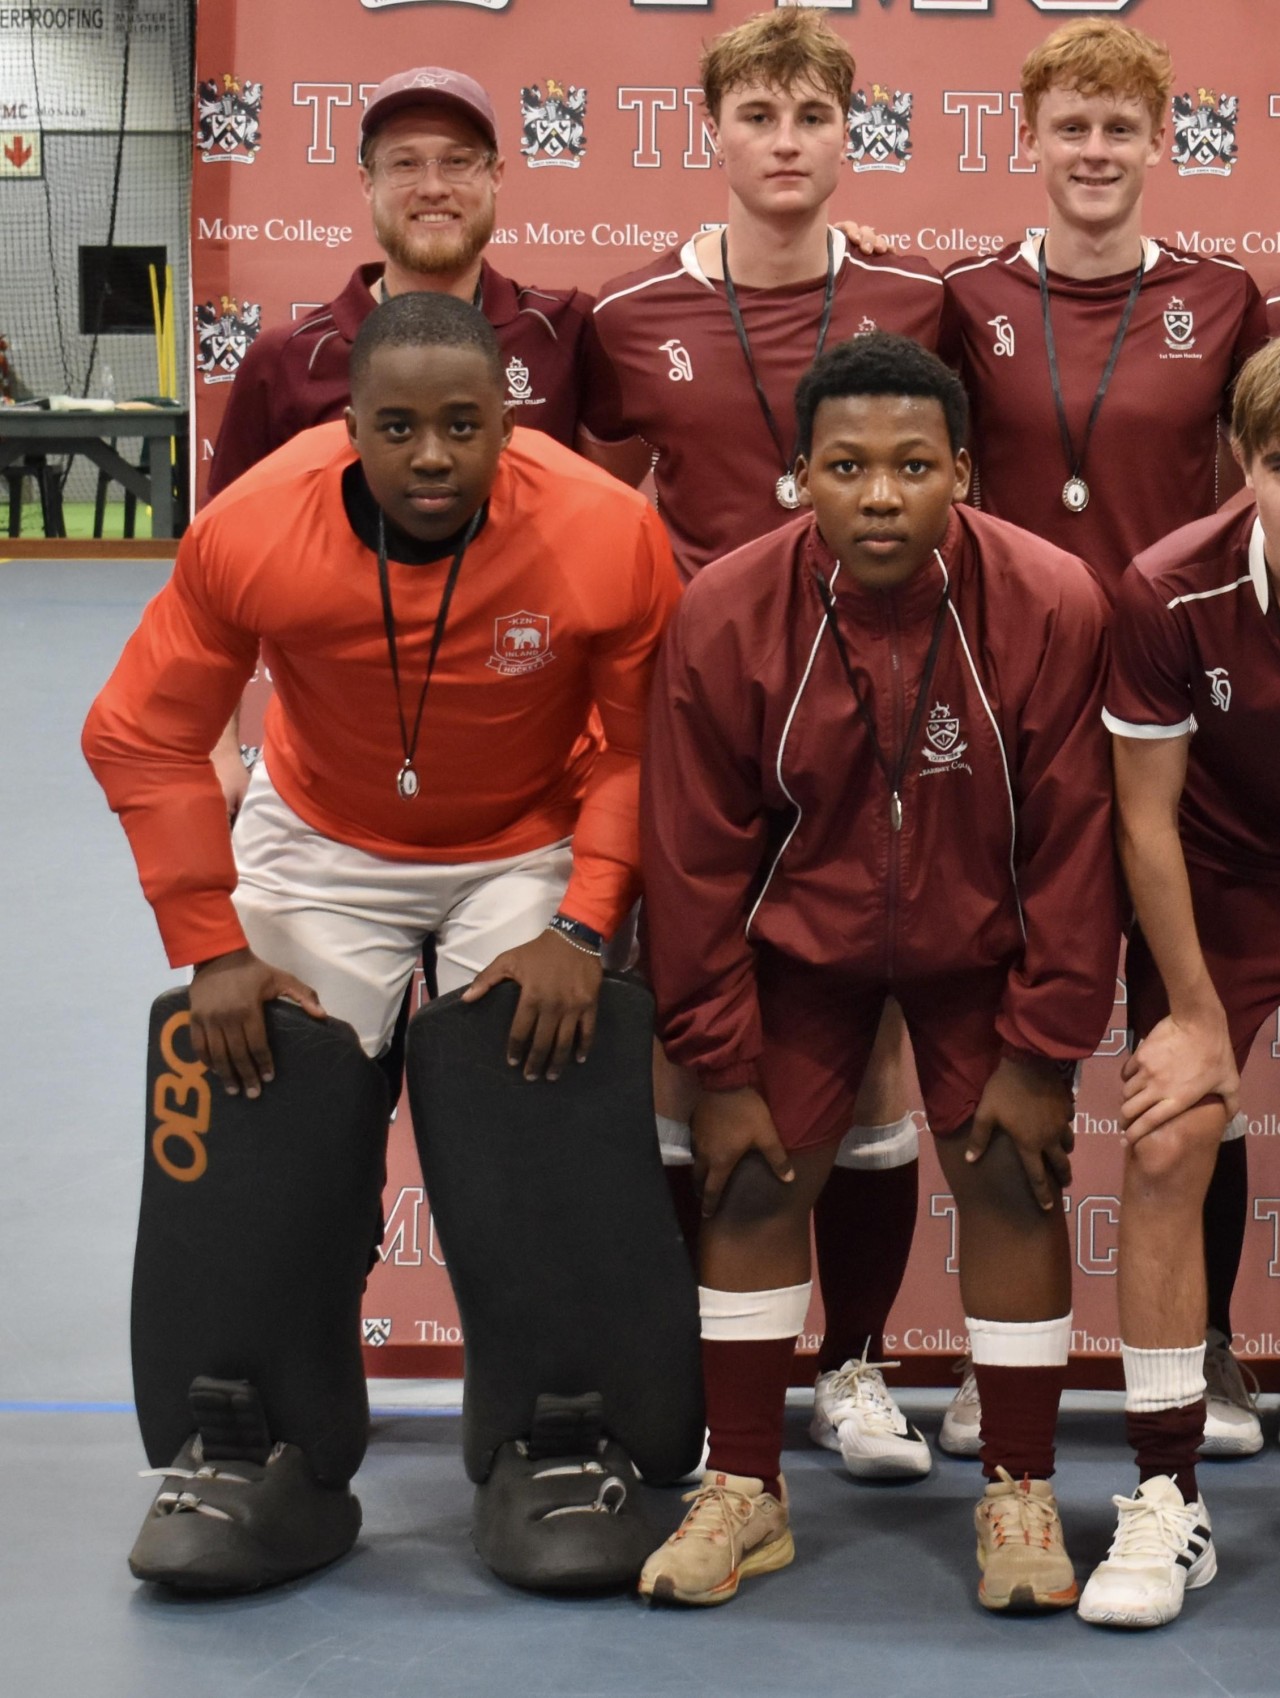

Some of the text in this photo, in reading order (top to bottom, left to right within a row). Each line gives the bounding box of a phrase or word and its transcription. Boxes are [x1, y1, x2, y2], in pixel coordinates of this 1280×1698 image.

[197, 218, 352, 248] More College
[525, 223, 585, 245] More
[591, 224, 679, 252] College
[917, 228, 1004, 257] College
[1176, 231, 1236, 253] More
[505, 650, 539, 658] INLAND
[503, 663, 539, 674] HOCKEY
[153, 1010, 212, 1182] OBO
[414, 1320, 464, 1343] Tho
